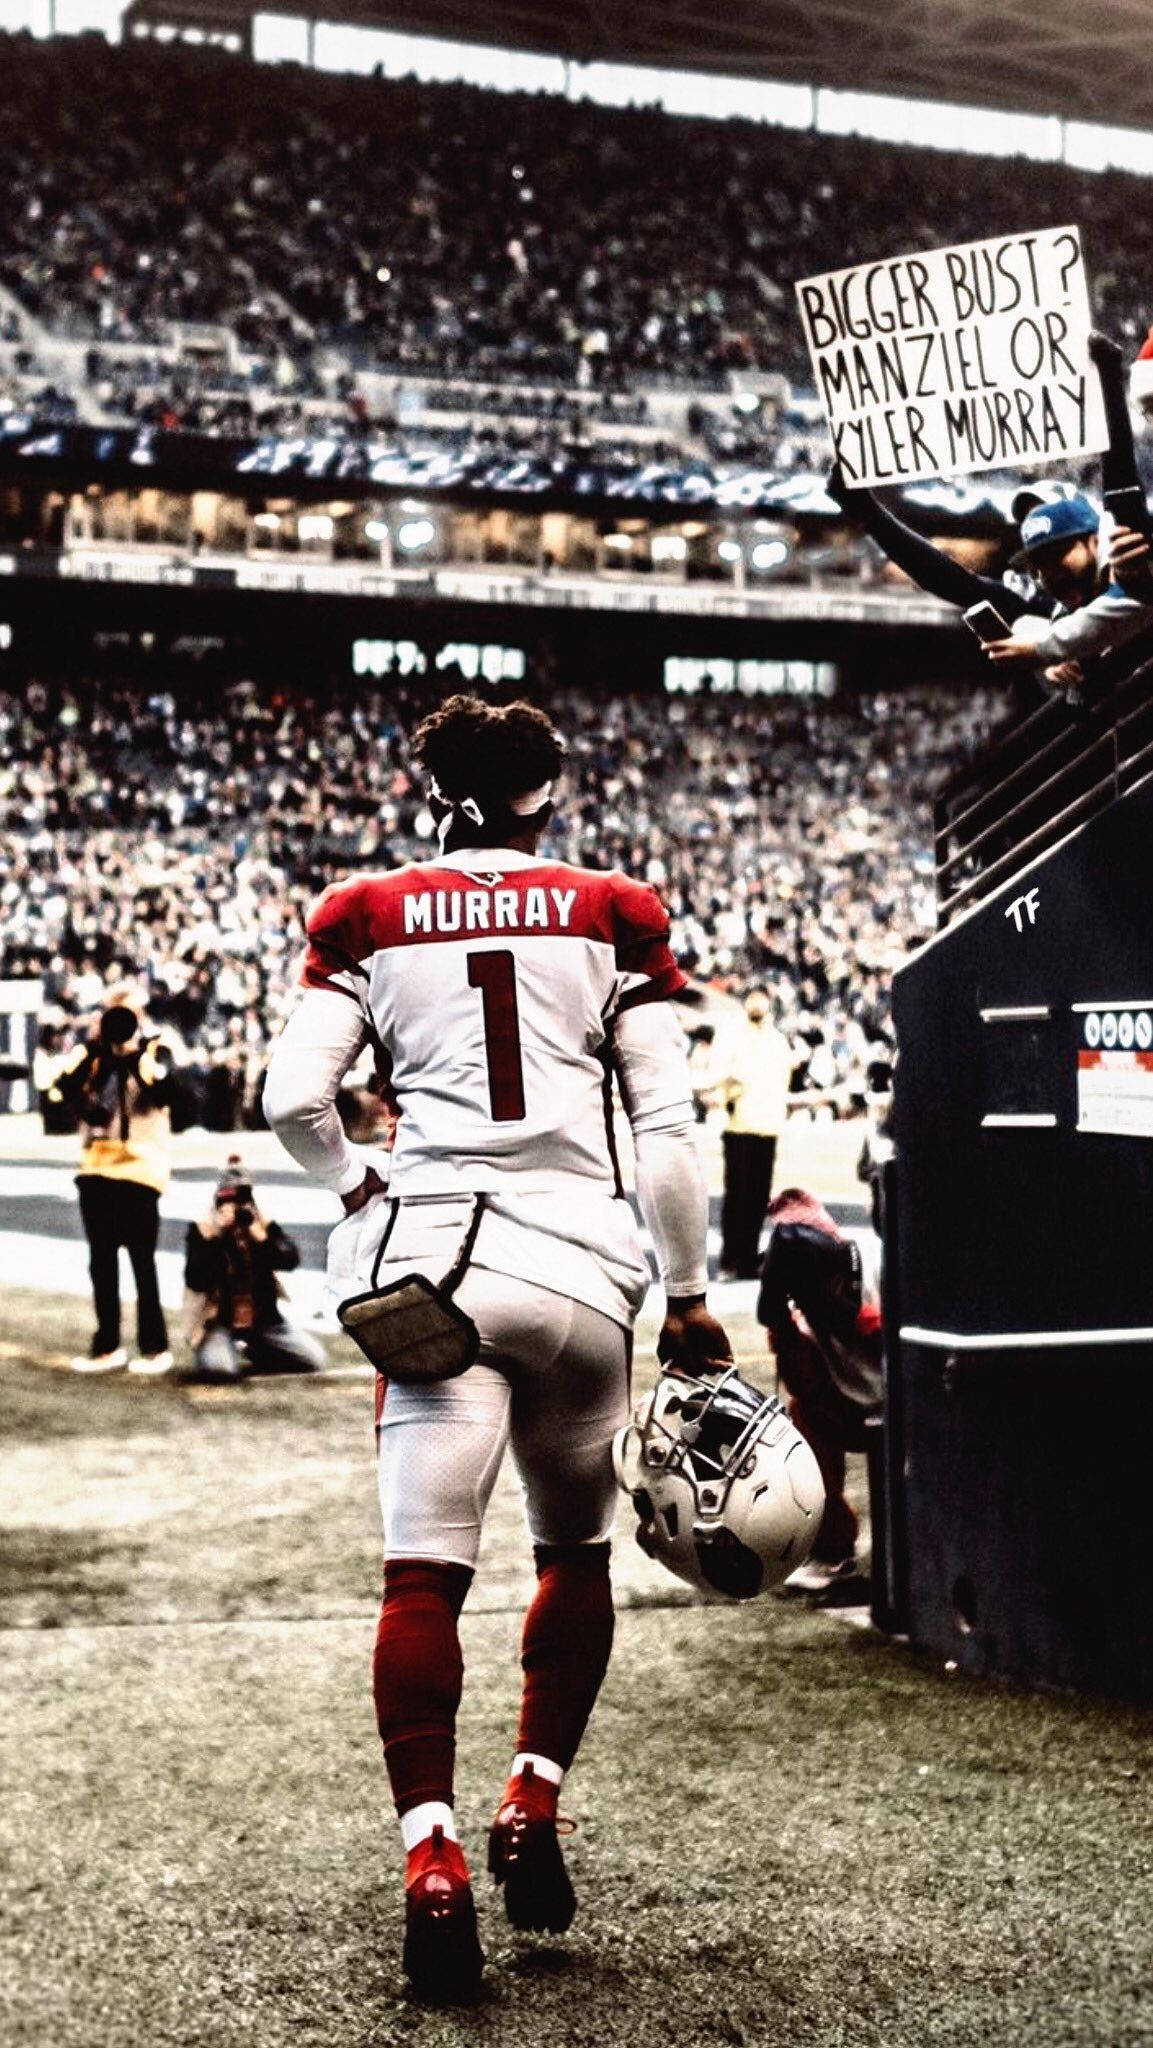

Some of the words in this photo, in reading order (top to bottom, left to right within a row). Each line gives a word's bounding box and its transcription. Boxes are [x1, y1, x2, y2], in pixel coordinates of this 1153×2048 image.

[802, 260, 939, 349] BIGGER
[819, 325, 998, 417] MANZIEL
[1010, 311, 1077, 380] OR
[830, 406, 939, 480] KYLER
[943, 375, 1086, 466] MURRAY
[404, 888, 576, 934] MURRAY
[466, 949, 526, 1122] 1
